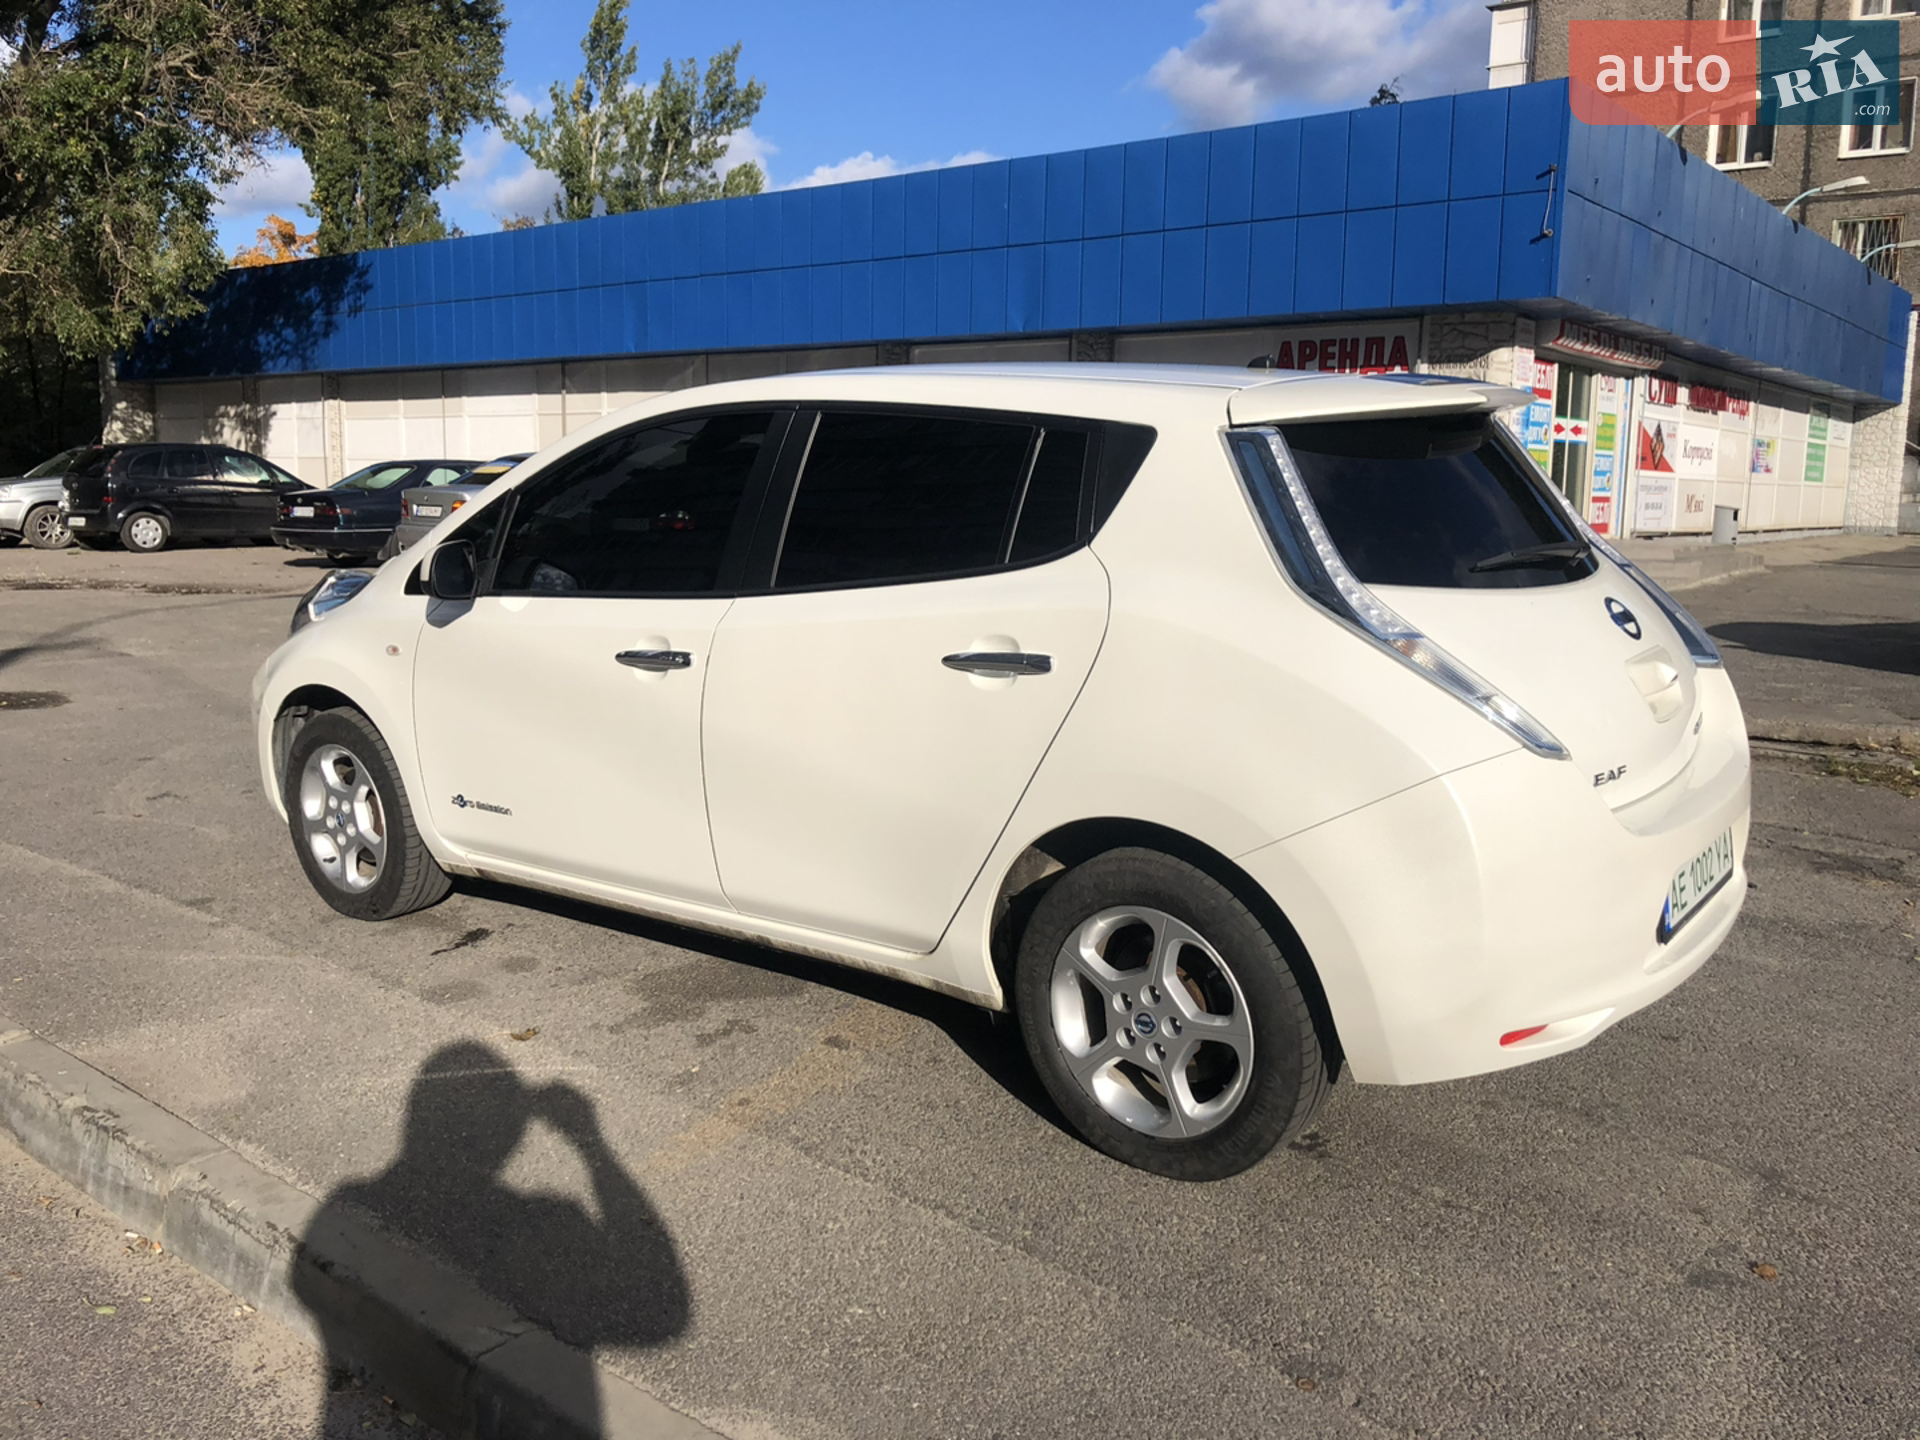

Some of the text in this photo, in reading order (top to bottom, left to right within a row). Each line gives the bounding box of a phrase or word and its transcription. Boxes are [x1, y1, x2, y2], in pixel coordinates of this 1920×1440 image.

[1276, 335, 1409, 375] АРЕНДА
[1682, 438, 1715, 466] Корпусні
[1593, 765, 1628, 788] EAF
[1670, 831, 1730, 919] AE 1002 YA
